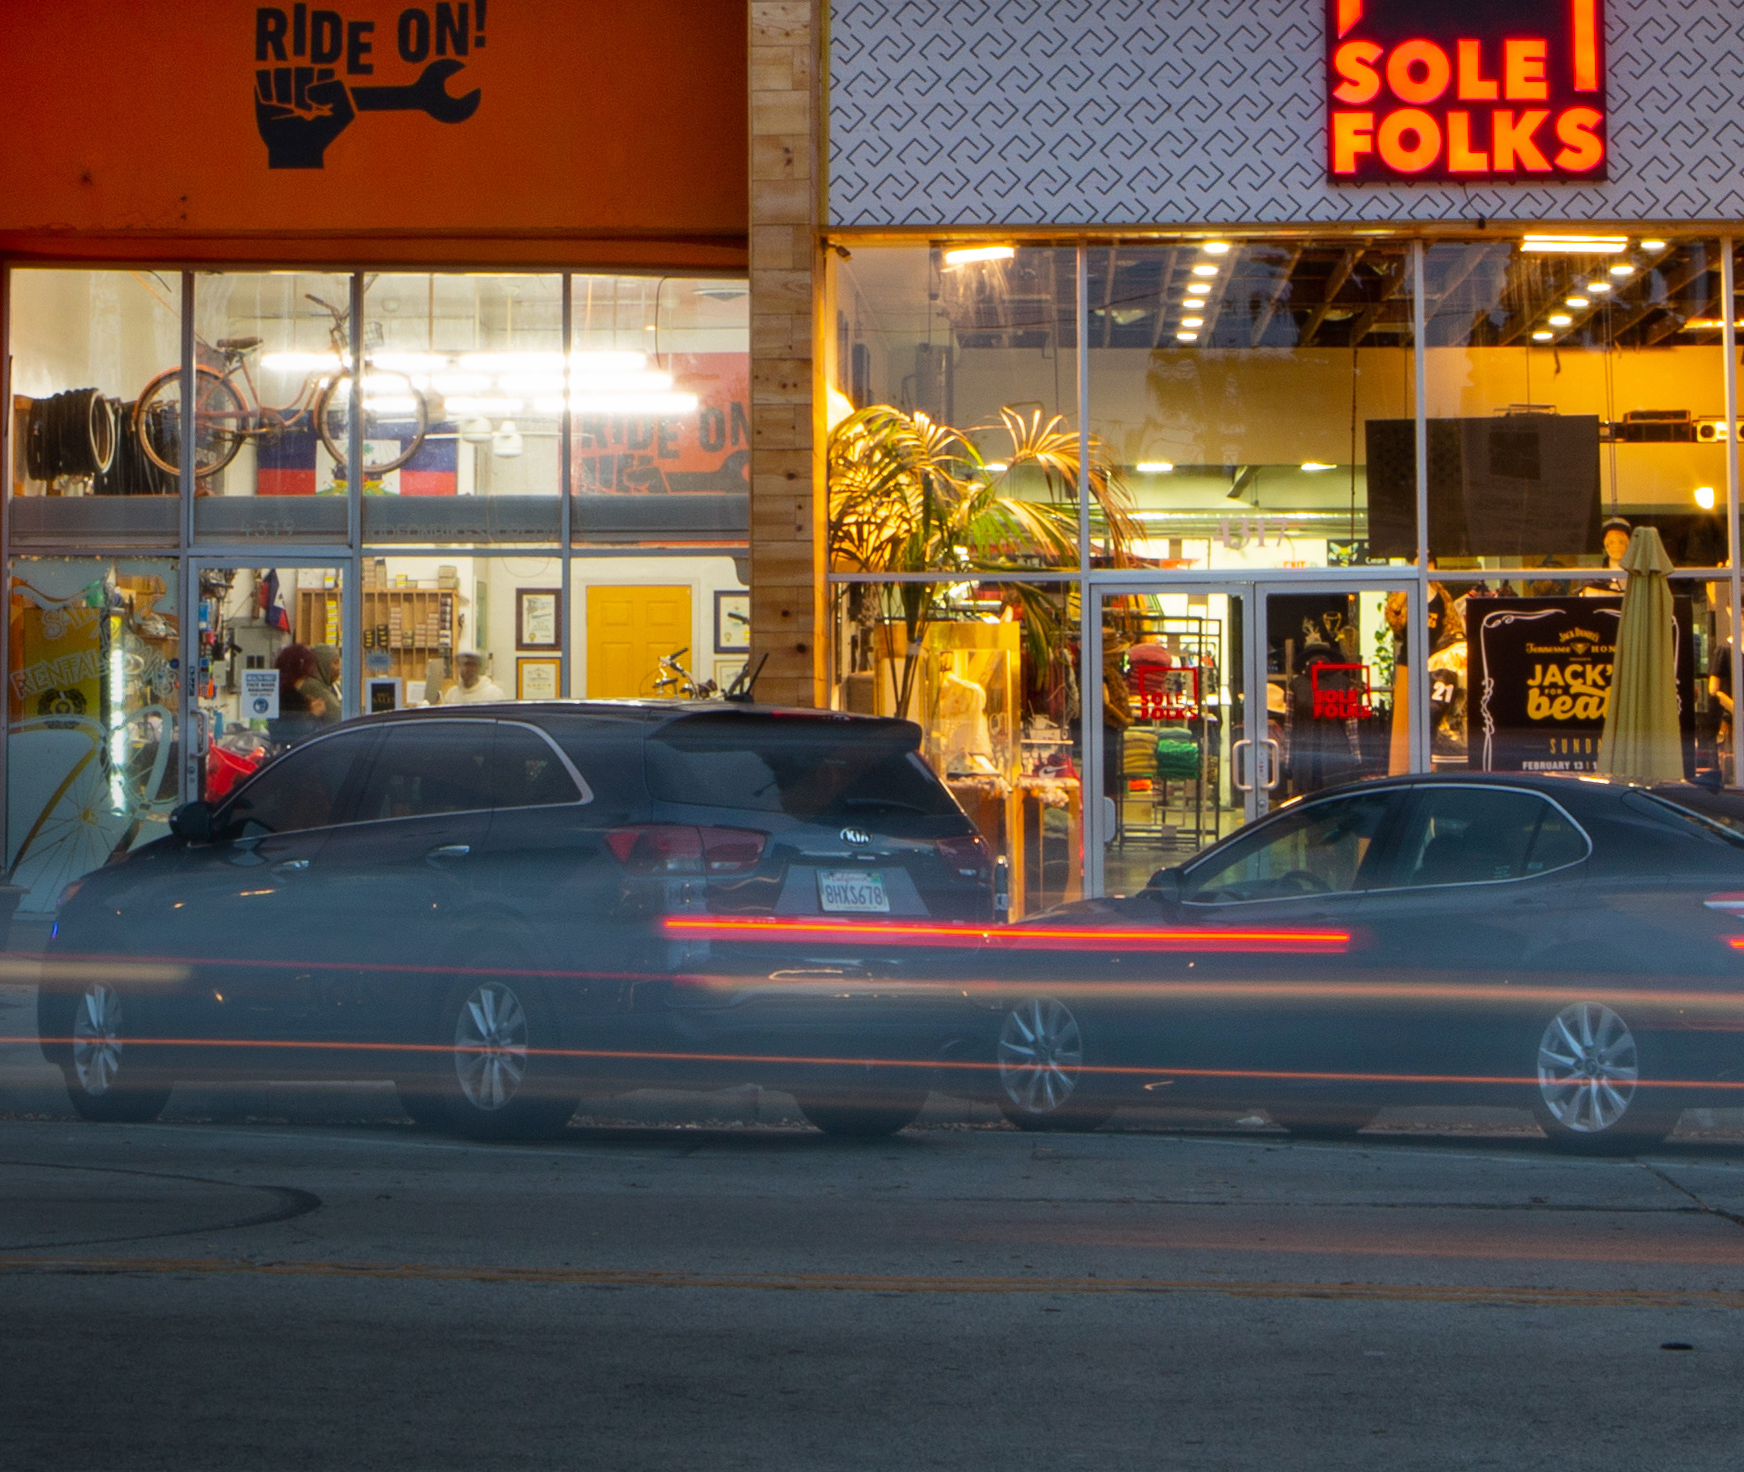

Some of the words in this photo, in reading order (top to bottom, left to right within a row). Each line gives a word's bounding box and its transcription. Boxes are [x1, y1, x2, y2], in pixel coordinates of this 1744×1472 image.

[256, 3, 375, 75] RIDE
[1333, 36, 1550, 105] SOLE
[1331, 106, 1606, 174] FOLKS
[581, 413, 680, 460] RIDE
[1212, 517, 1288, 550] 4317
[1525, 642, 1572, 655] Tennessee
[1140, 691, 1189, 706] SOLE
[1313, 689, 1359, 704] SOLE
[1431, 680, 1455, 704] 21
[1140, 706, 1199, 721] FOLKS
[1313, 703, 1373, 720] FOLKS
[1522, 760, 1571, 771] FEBRUARY
[1573, 760, 1584, 771] 13
[824, 884, 884, 906] 8HXS678
